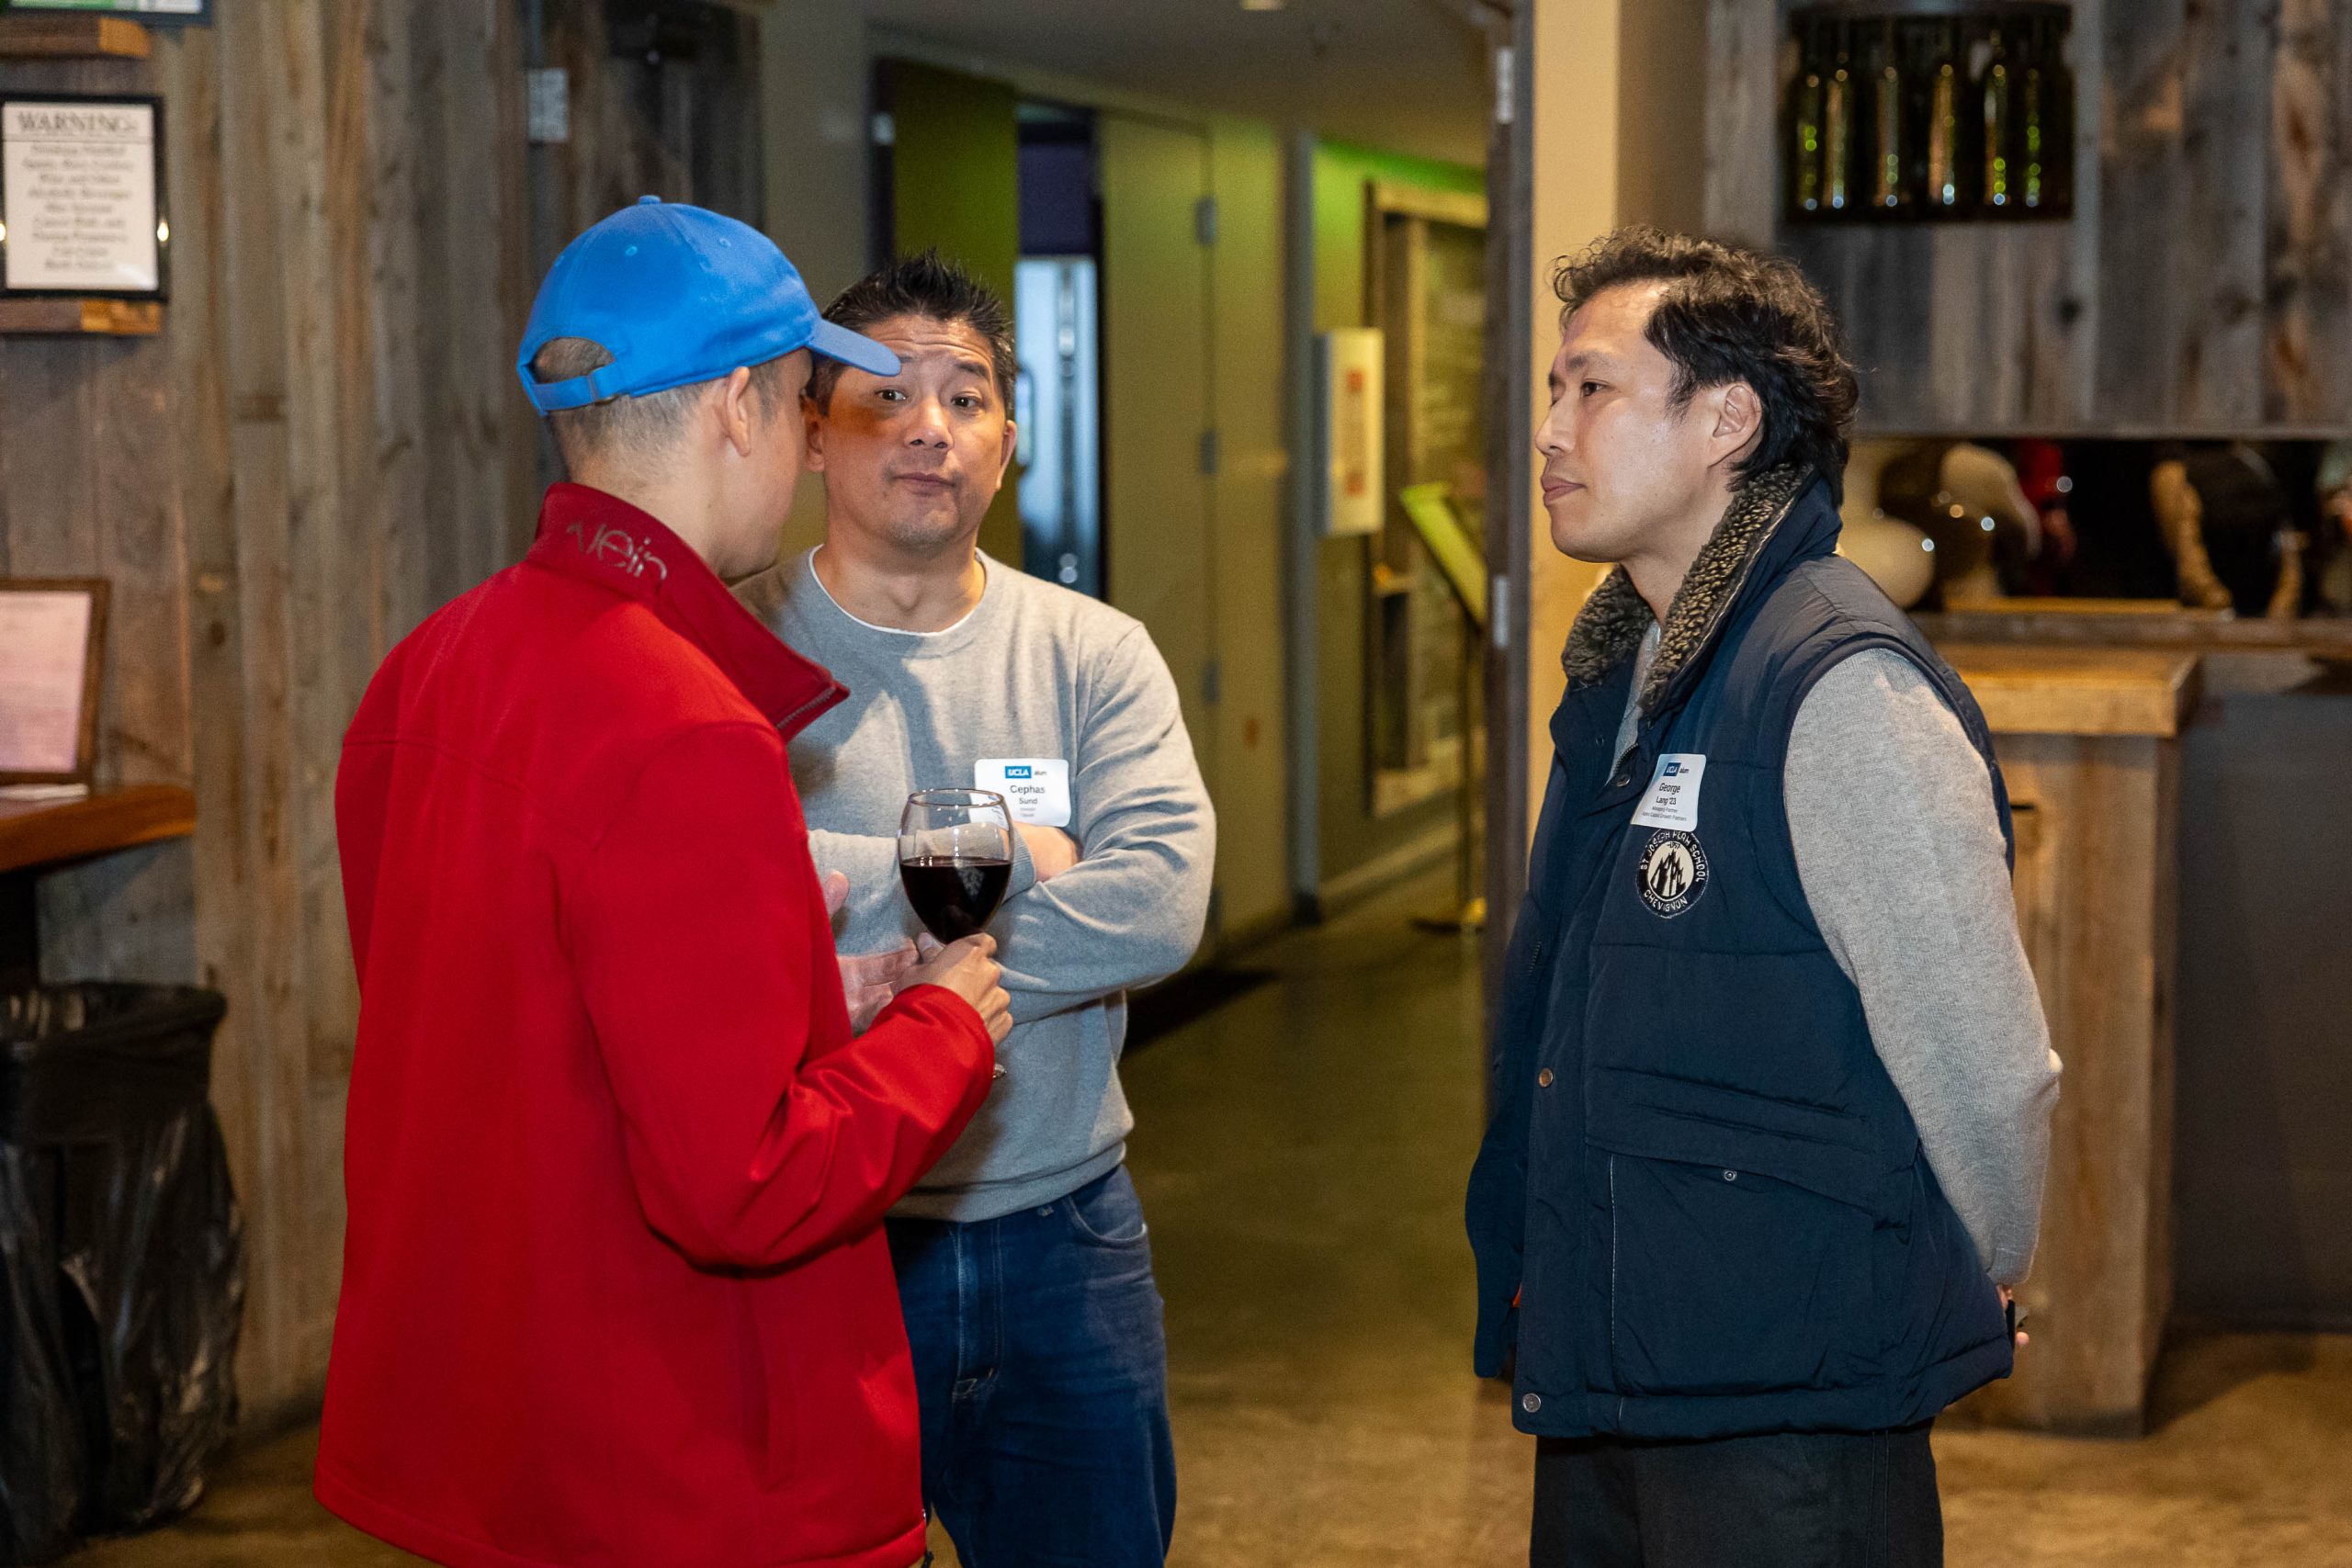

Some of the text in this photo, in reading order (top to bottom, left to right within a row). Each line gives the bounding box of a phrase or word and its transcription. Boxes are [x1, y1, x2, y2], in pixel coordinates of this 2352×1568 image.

[1008, 768, 1030, 777] UCLA
[1010, 784, 1046, 795] Cephas
[1658, 783, 1681, 795] George
[1656, 796, 1668, 806] Lang
[1690, 843, 1706, 882] SCHOOL
[1644, 889, 1689, 911] CHEVIGNON
